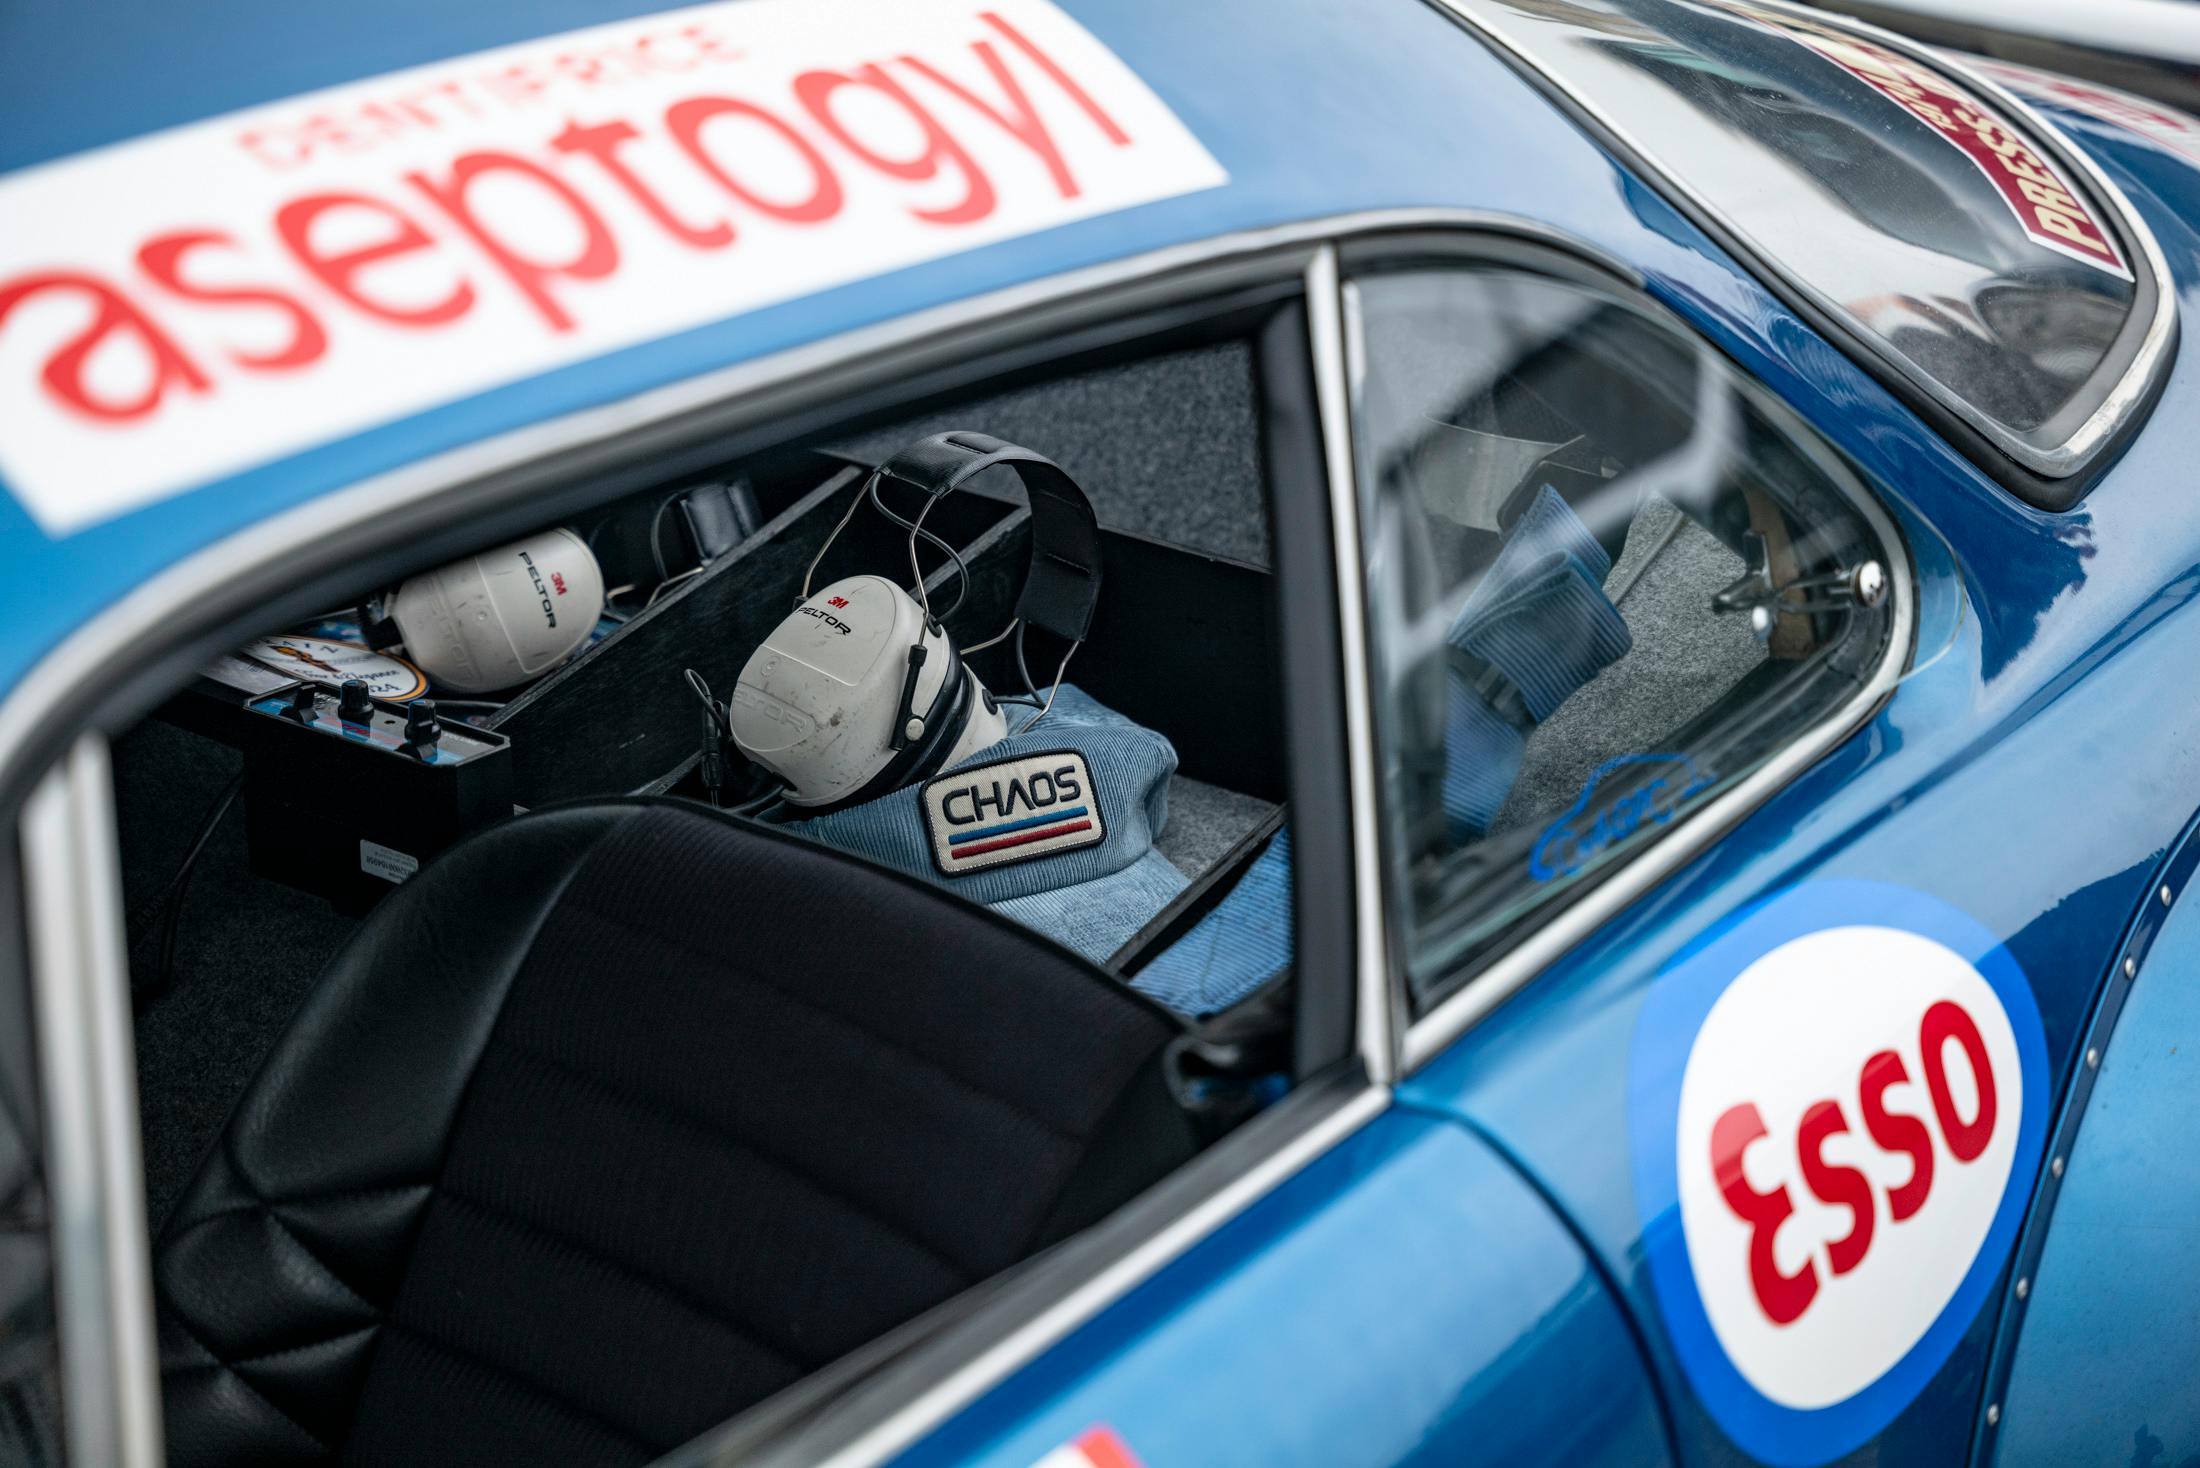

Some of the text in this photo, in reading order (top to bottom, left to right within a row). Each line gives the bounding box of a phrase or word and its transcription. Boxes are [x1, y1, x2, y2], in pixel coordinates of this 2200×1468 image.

[0, 11, 1133, 426] aseptogyl
[518, 551, 557, 629] PELTOR
[551, 571, 568, 597] 3M
[827, 596, 850, 608] 3M
[942, 765, 1081, 826] CHAOS
